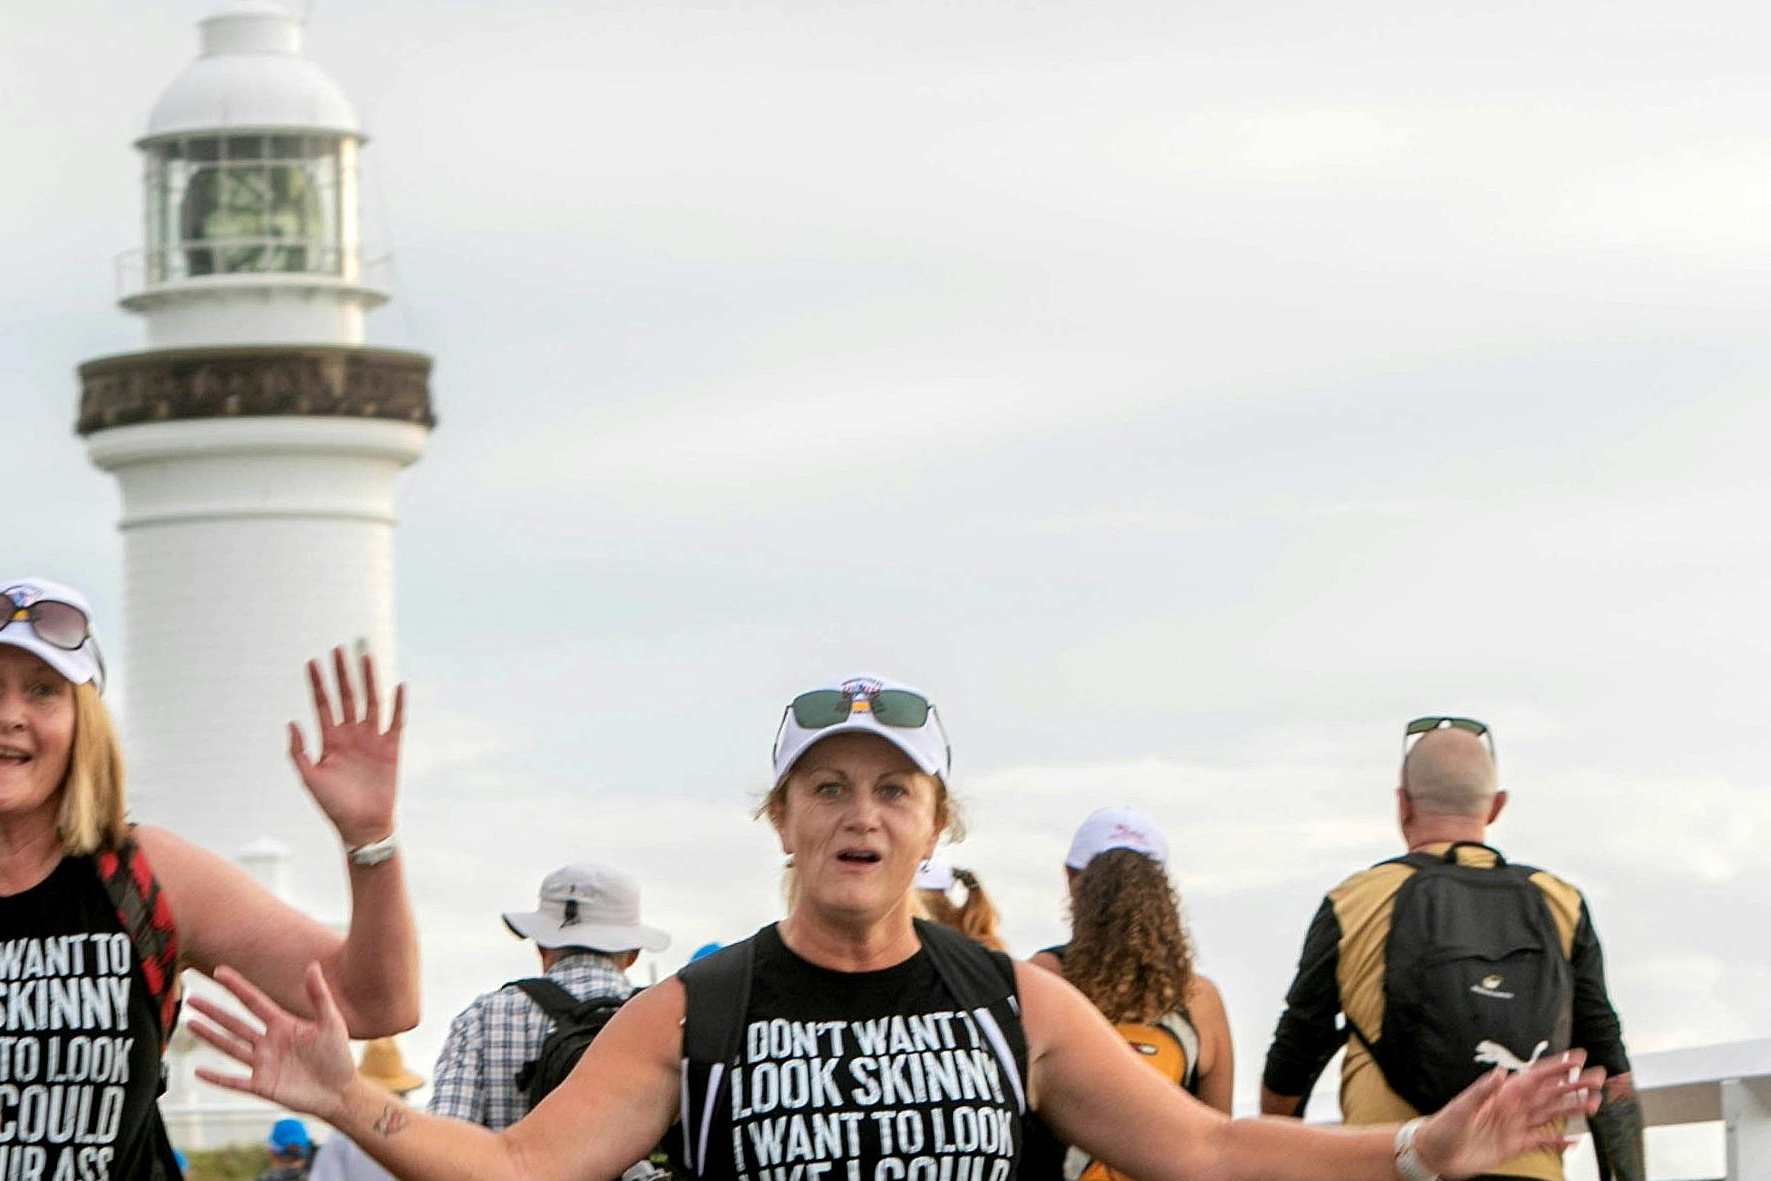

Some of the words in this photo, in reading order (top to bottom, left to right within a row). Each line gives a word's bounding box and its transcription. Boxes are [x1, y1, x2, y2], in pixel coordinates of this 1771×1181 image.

[90, 932, 131, 976] TO
[46, 1035, 134, 1084] LOOK
[746, 1018, 848, 1065] DON'T
[851, 1011, 956, 1057] WANT
[730, 1056, 845, 1122] LOOK
[848, 1049, 1006, 1107] SKINNY
[732, 1124, 746, 1173] I
[747, 1111, 865, 1168] WANT
[871, 1109, 925, 1156] TO
[930, 1106, 1014, 1158] LOOK
